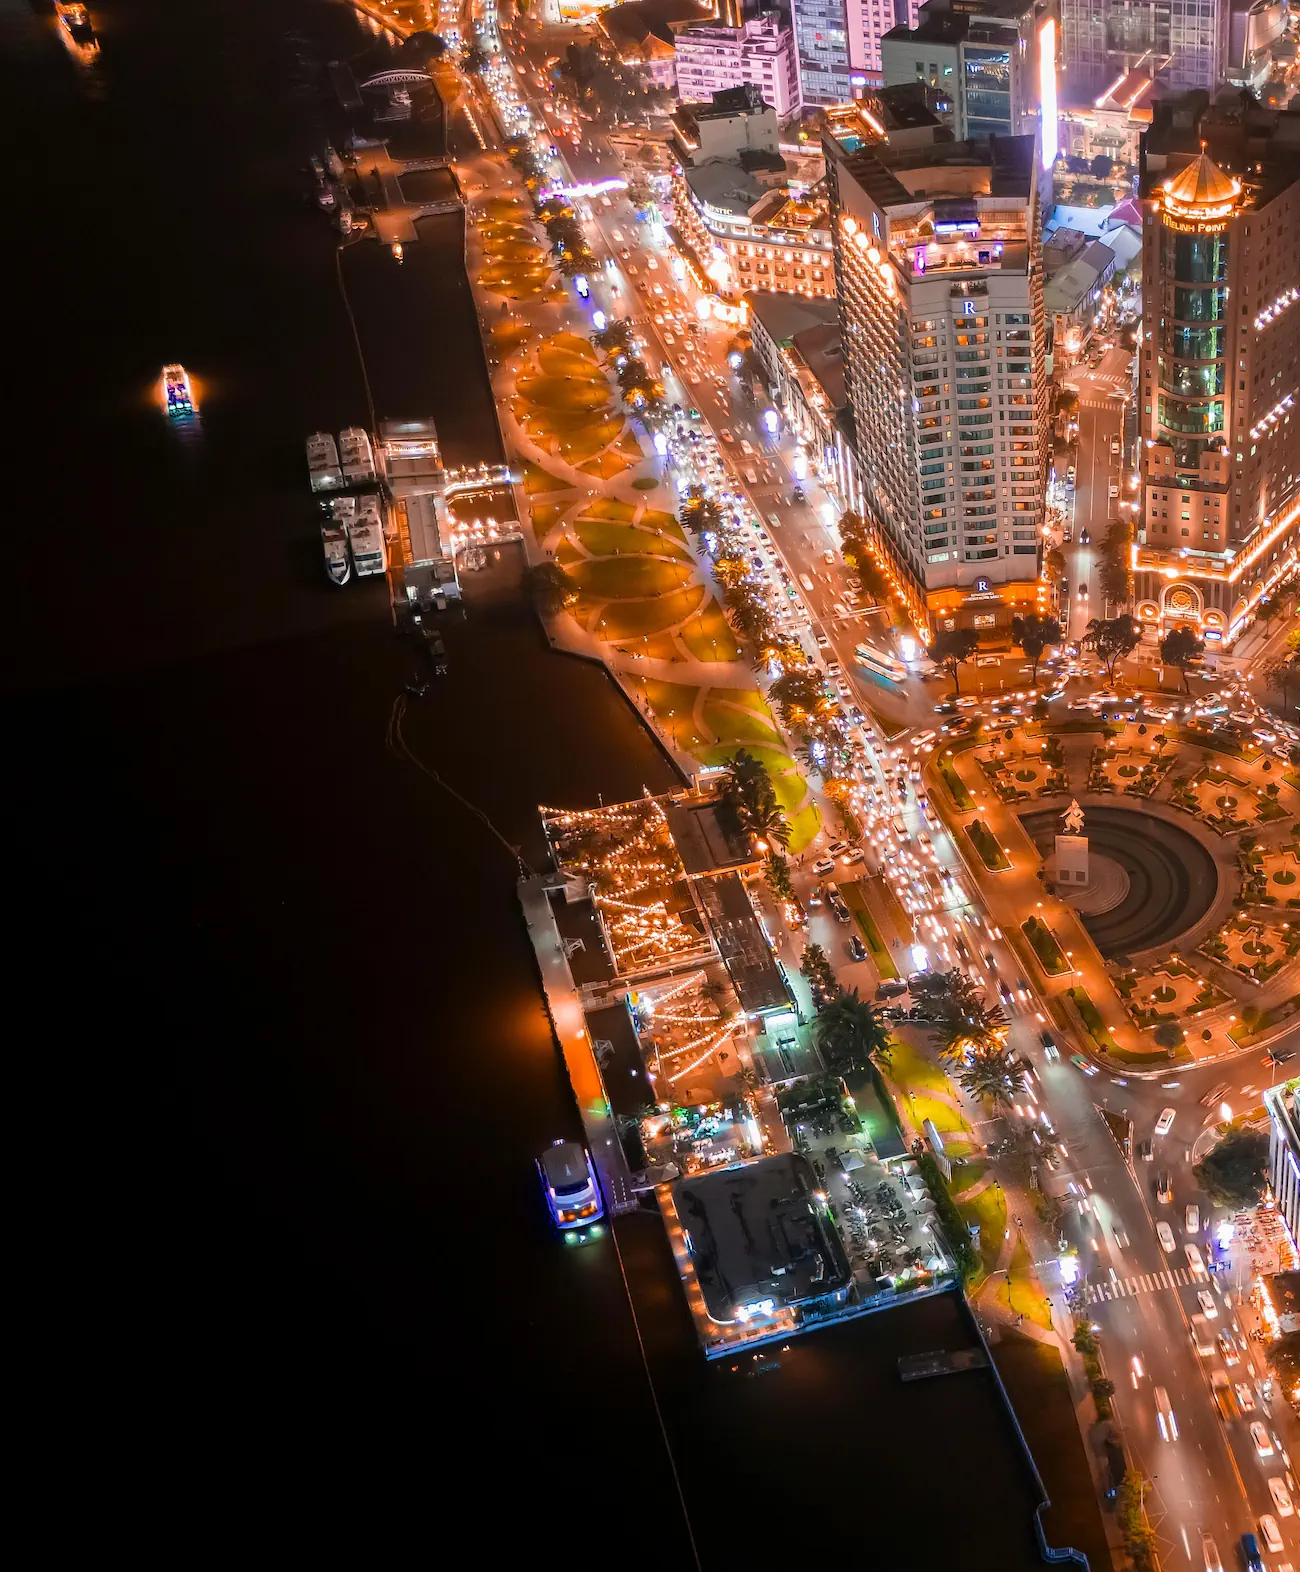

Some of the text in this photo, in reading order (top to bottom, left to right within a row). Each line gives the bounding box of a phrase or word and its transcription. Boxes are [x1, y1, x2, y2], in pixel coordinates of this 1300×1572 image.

[1197, 222, 1228, 233] POINT
[964, 301, 976, 315] R
[978, 581, 989, 591] R
